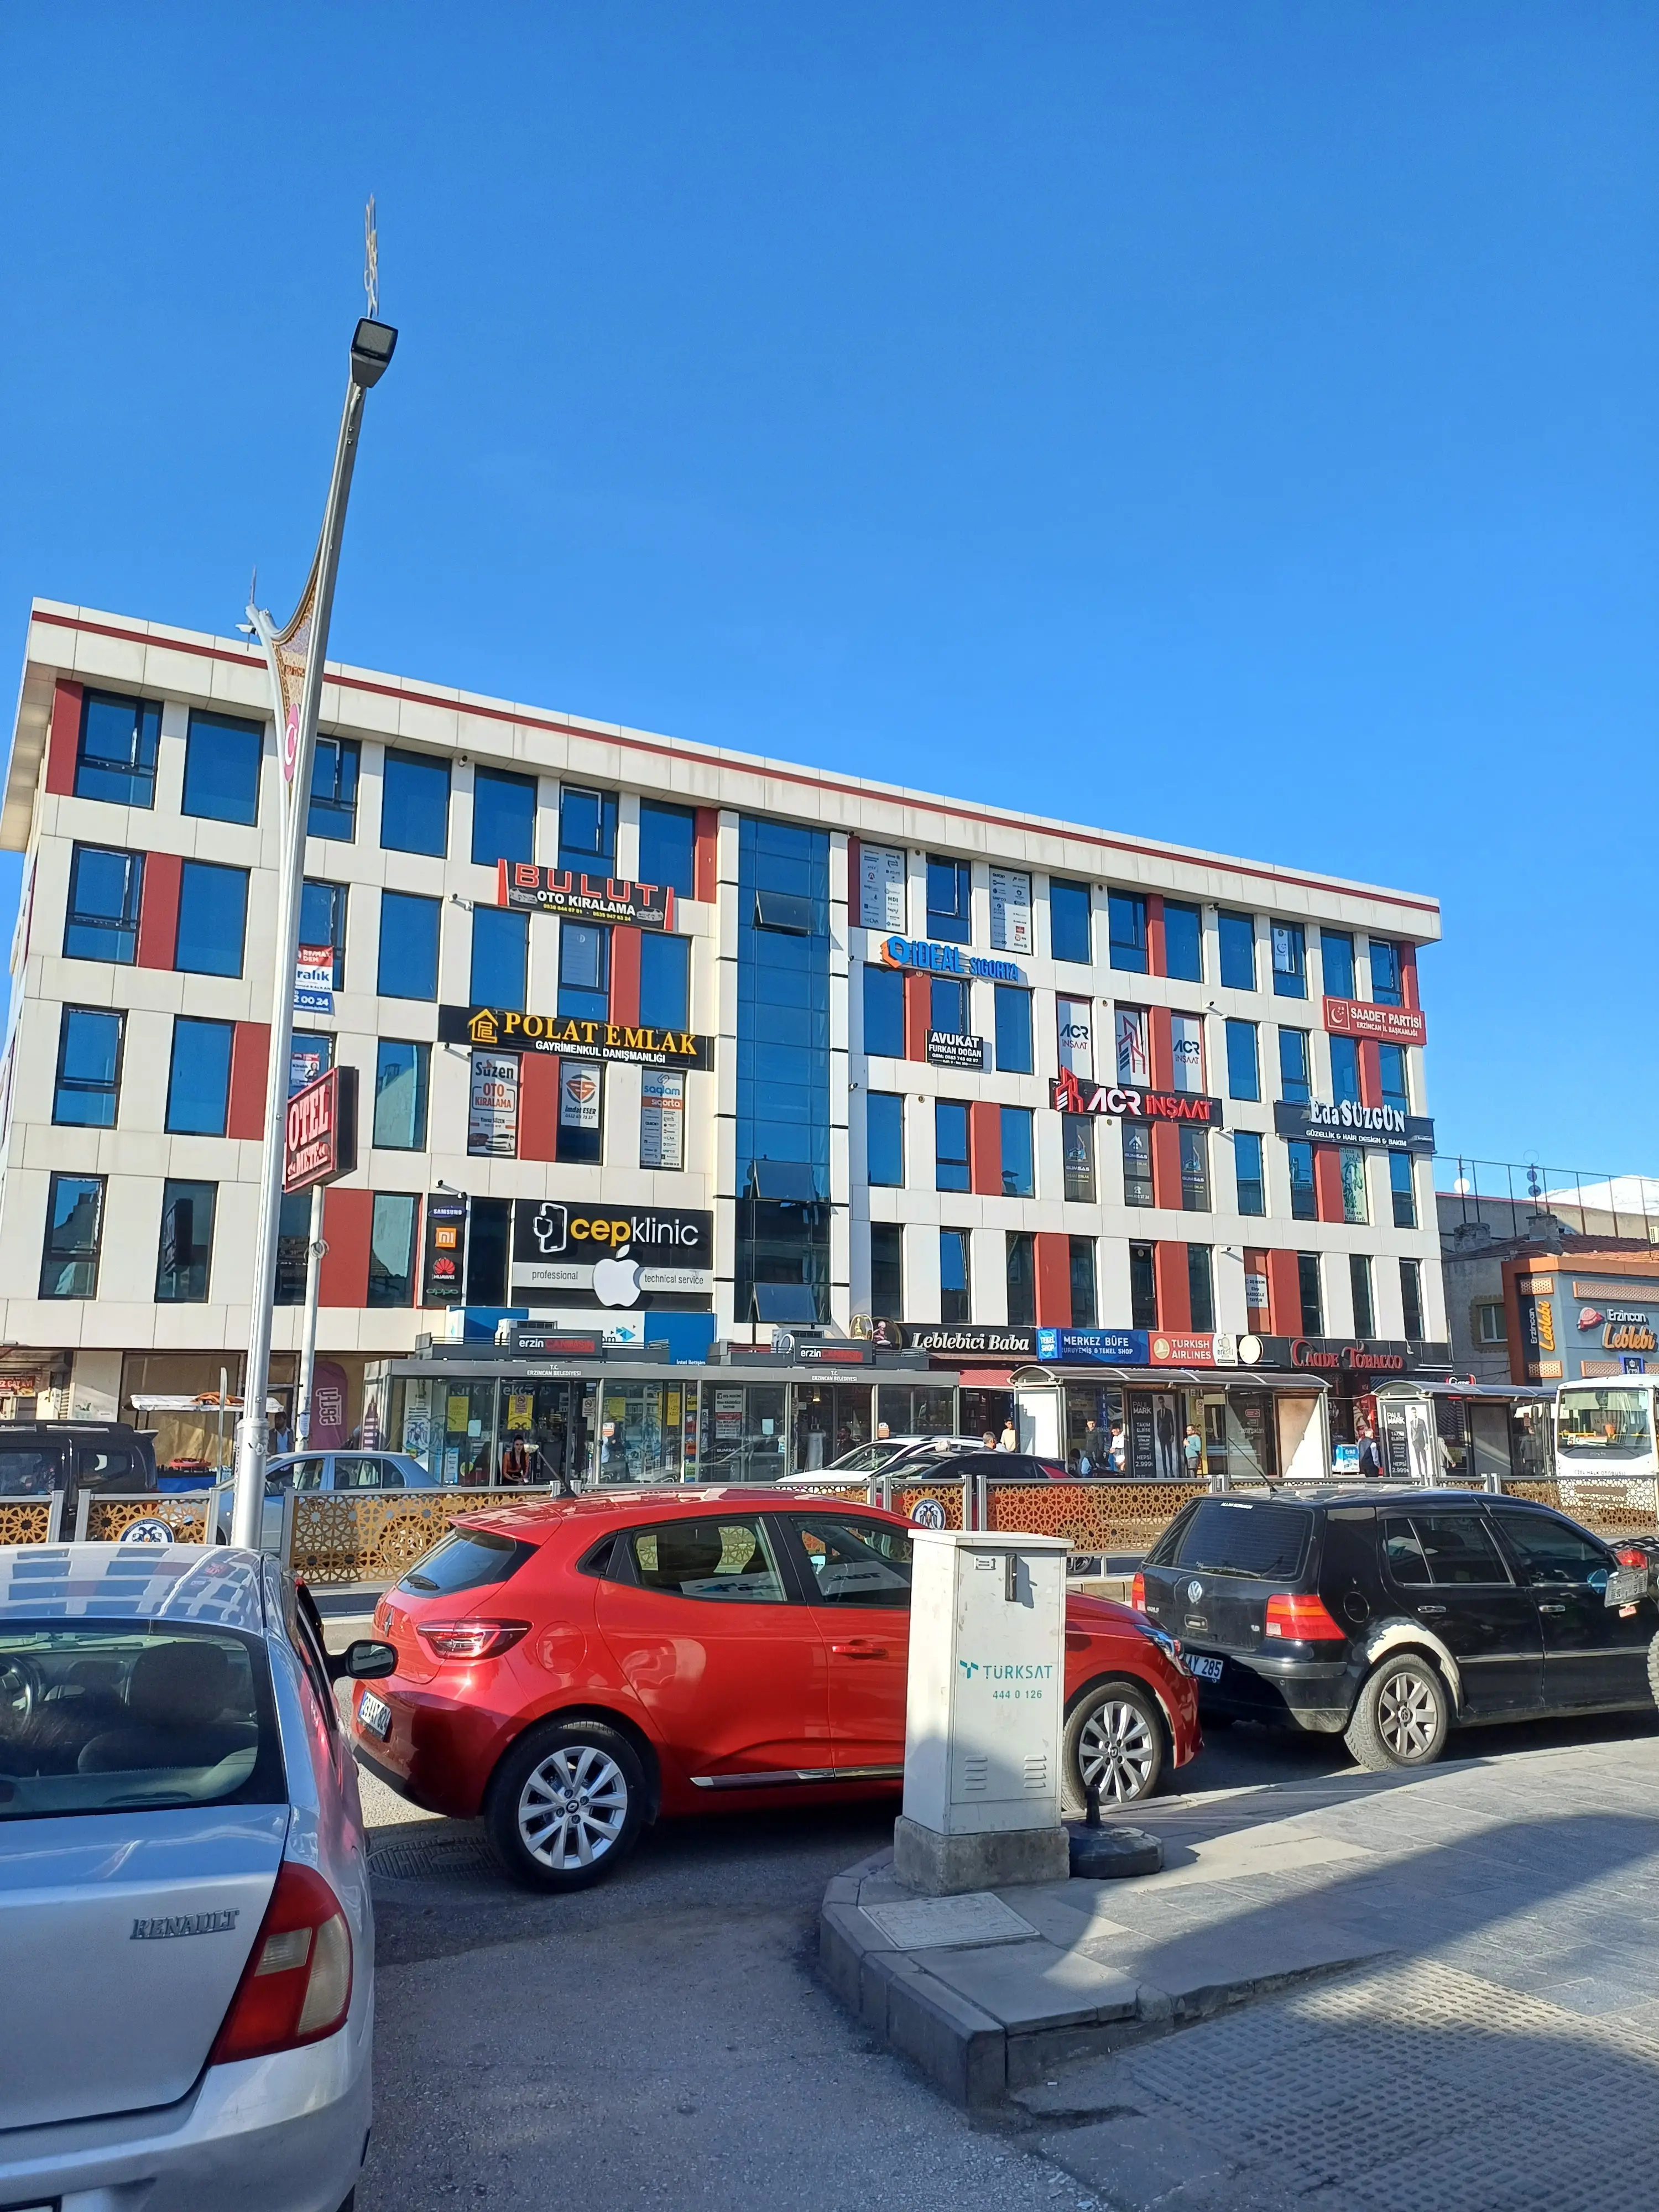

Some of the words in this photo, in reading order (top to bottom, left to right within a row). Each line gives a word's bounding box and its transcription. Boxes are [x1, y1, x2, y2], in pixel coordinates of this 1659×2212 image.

[515, 863, 658, 906] BULUT
[538, 890, 565, 904] OTO
[297, 970, 330, 982] ralık
[300, 995, 315, 1004] 00
[316, 997, 329, 1006] 24
[1351, 1008, 1386, 1022] SAADET
[1389, 1013, 1422, 1029] PARTİSİ
[504, 1012, 599, 1043] POLAT
[605, 1024, 698, 1055] EMLAK
[1357, 1021, 1381, 1031] ERZİNCAN
[1389, 1027, 1418, 1036] BAŞKANLIĞI
[931, 1032, 979, 1048] AVUKAT
[535, 1040, 601, 1057] GAYRİMENKUL
[602, 1048, 666, 1063] DANIŞMANLIĞI
[929, 1044, 956, 1055] FURKAN
[958, 1047, 982, 1057] DOĞAN
[483, 1083, 504, 1097] OTO
[475, 1097, 512, 1108] KİRALAMA
[1087, 1087, 1141, 1115] ACR
[1145, 1094, 1213, 1120] İNŞAAT
[289, 1084, 328, 1152] OTEL
[1309, 1096, 1339, 1125] Eda
[1340, 1099, 1405, 1133] SÜZGÜN
[1306, 1129, 1334, 1139] GÜZELLİK
[571, 1217, 698, 1247] cepklinic
[532, 1270, 578, 1280] professional
[645, 1274, 676, 1284] technical
[678, 1275, 703, 1284] service
[1606, 1308, 1646, 1322] Erzincan
[1537, 1301, 1554, 1351] Leblebi
[911, 1332, 985, 1349] Leblebici
[988, 1334, 1029, 1350] Baba
[1063, 1335, 1100, 1346] MERKEZ
[1105, 1335, 1129, 1347] BÜFE
[1602, 1322, 1656, 1350] Leblebi
[1041, 1344, 1055, 1353] SHOP
[1171, 1339, 1211, 1349] TURKISH
[1172, 1349, 1211, 1360] AIRLINES
[1342, 1341, 1403, 1369] TOBACCO
[983, 1665, 1052, 1679] TÜRKSAT
[1202, 1658, 1222, 1677] 285
[993, 1690, 1010, 1699] 444
[1015, 1690, 1020, 1699] 0
[1025, 1690, 1042, 1699] 126
[130, 1908, 240, 1939] RENAULT
